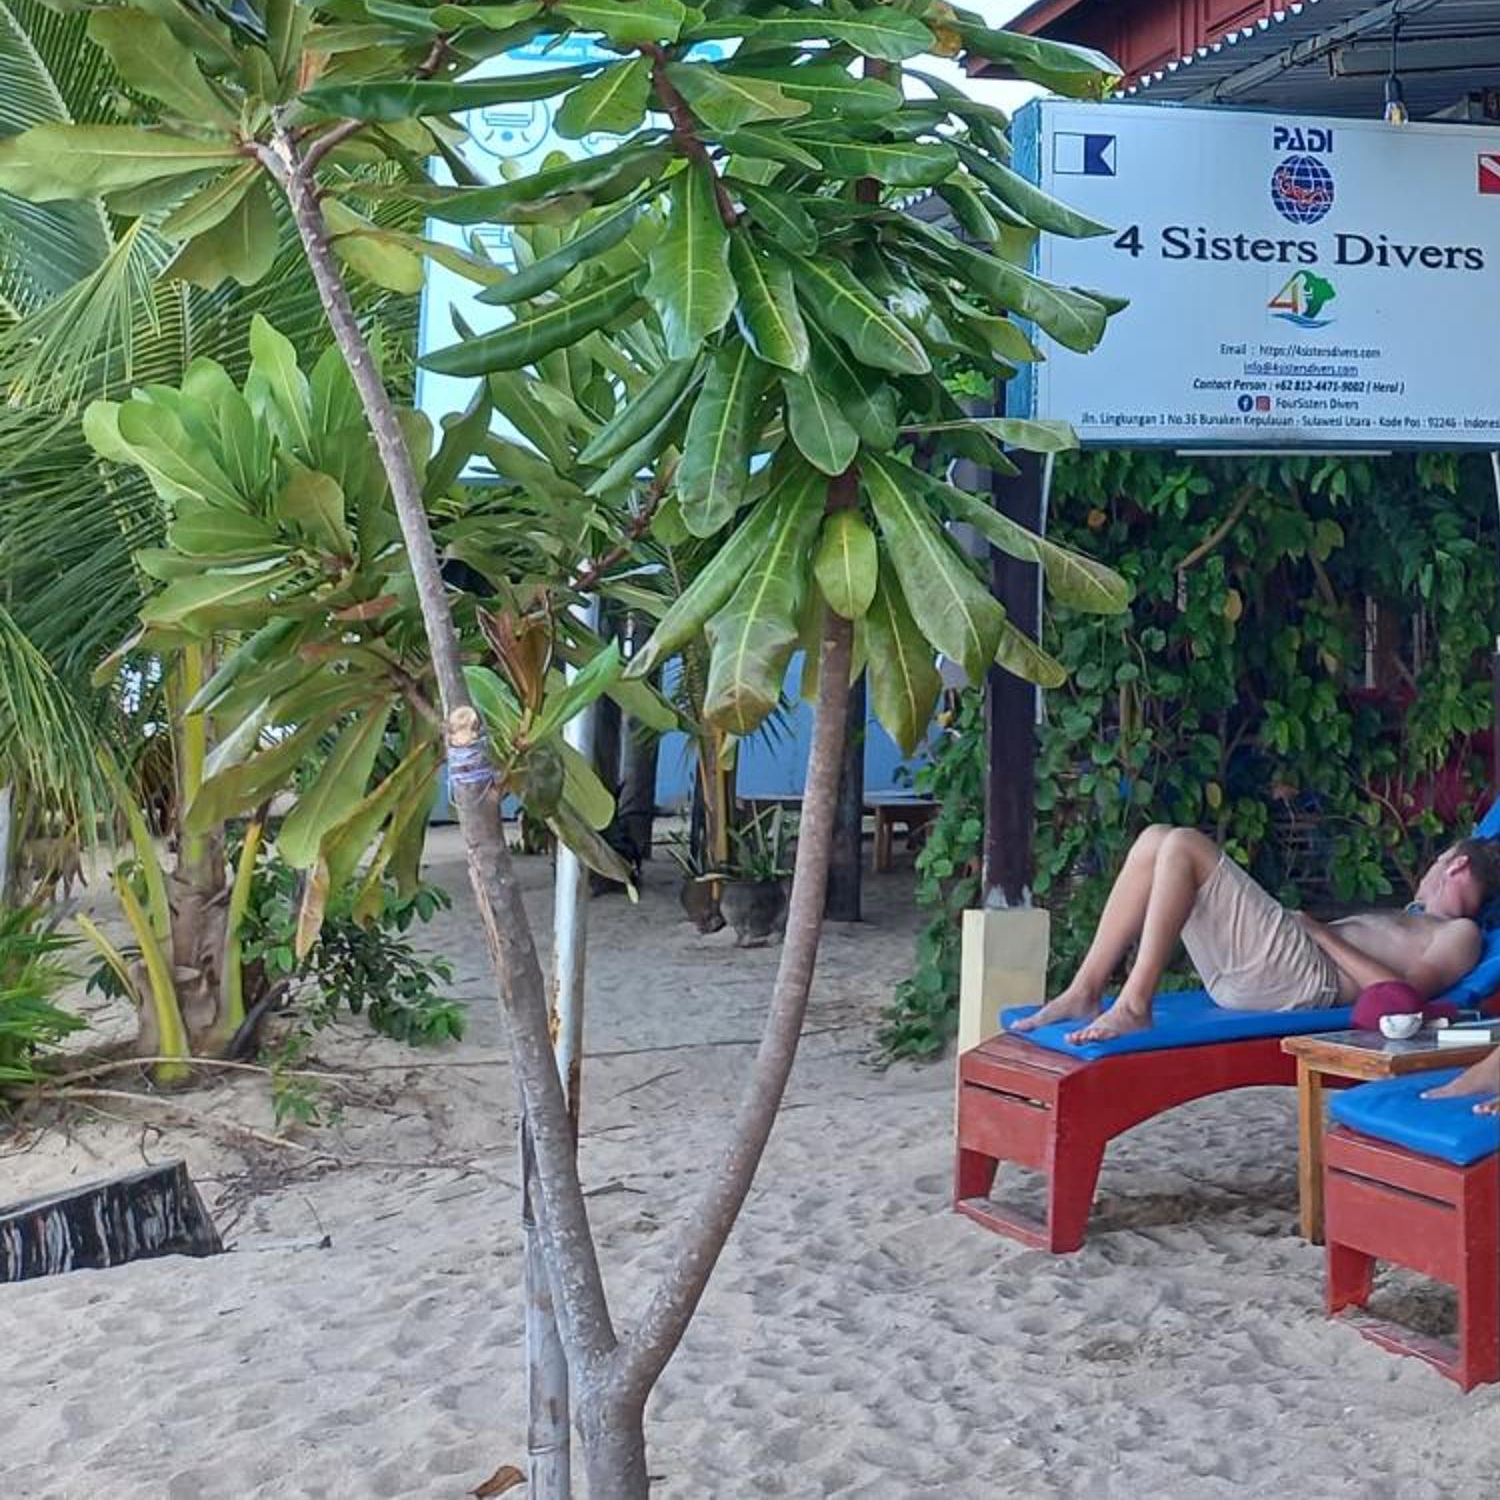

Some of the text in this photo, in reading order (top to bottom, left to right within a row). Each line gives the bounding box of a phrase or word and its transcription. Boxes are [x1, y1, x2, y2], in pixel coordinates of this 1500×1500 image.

[1273, 125, 1333, 153] PADI
[1114, 225, 1484, 270] 4 Sisters Divers
[1220, 343, 1246, 355] Email
[1193, 378, 1231, 390] Contact
[1233, 379, 1267, 390] Person
